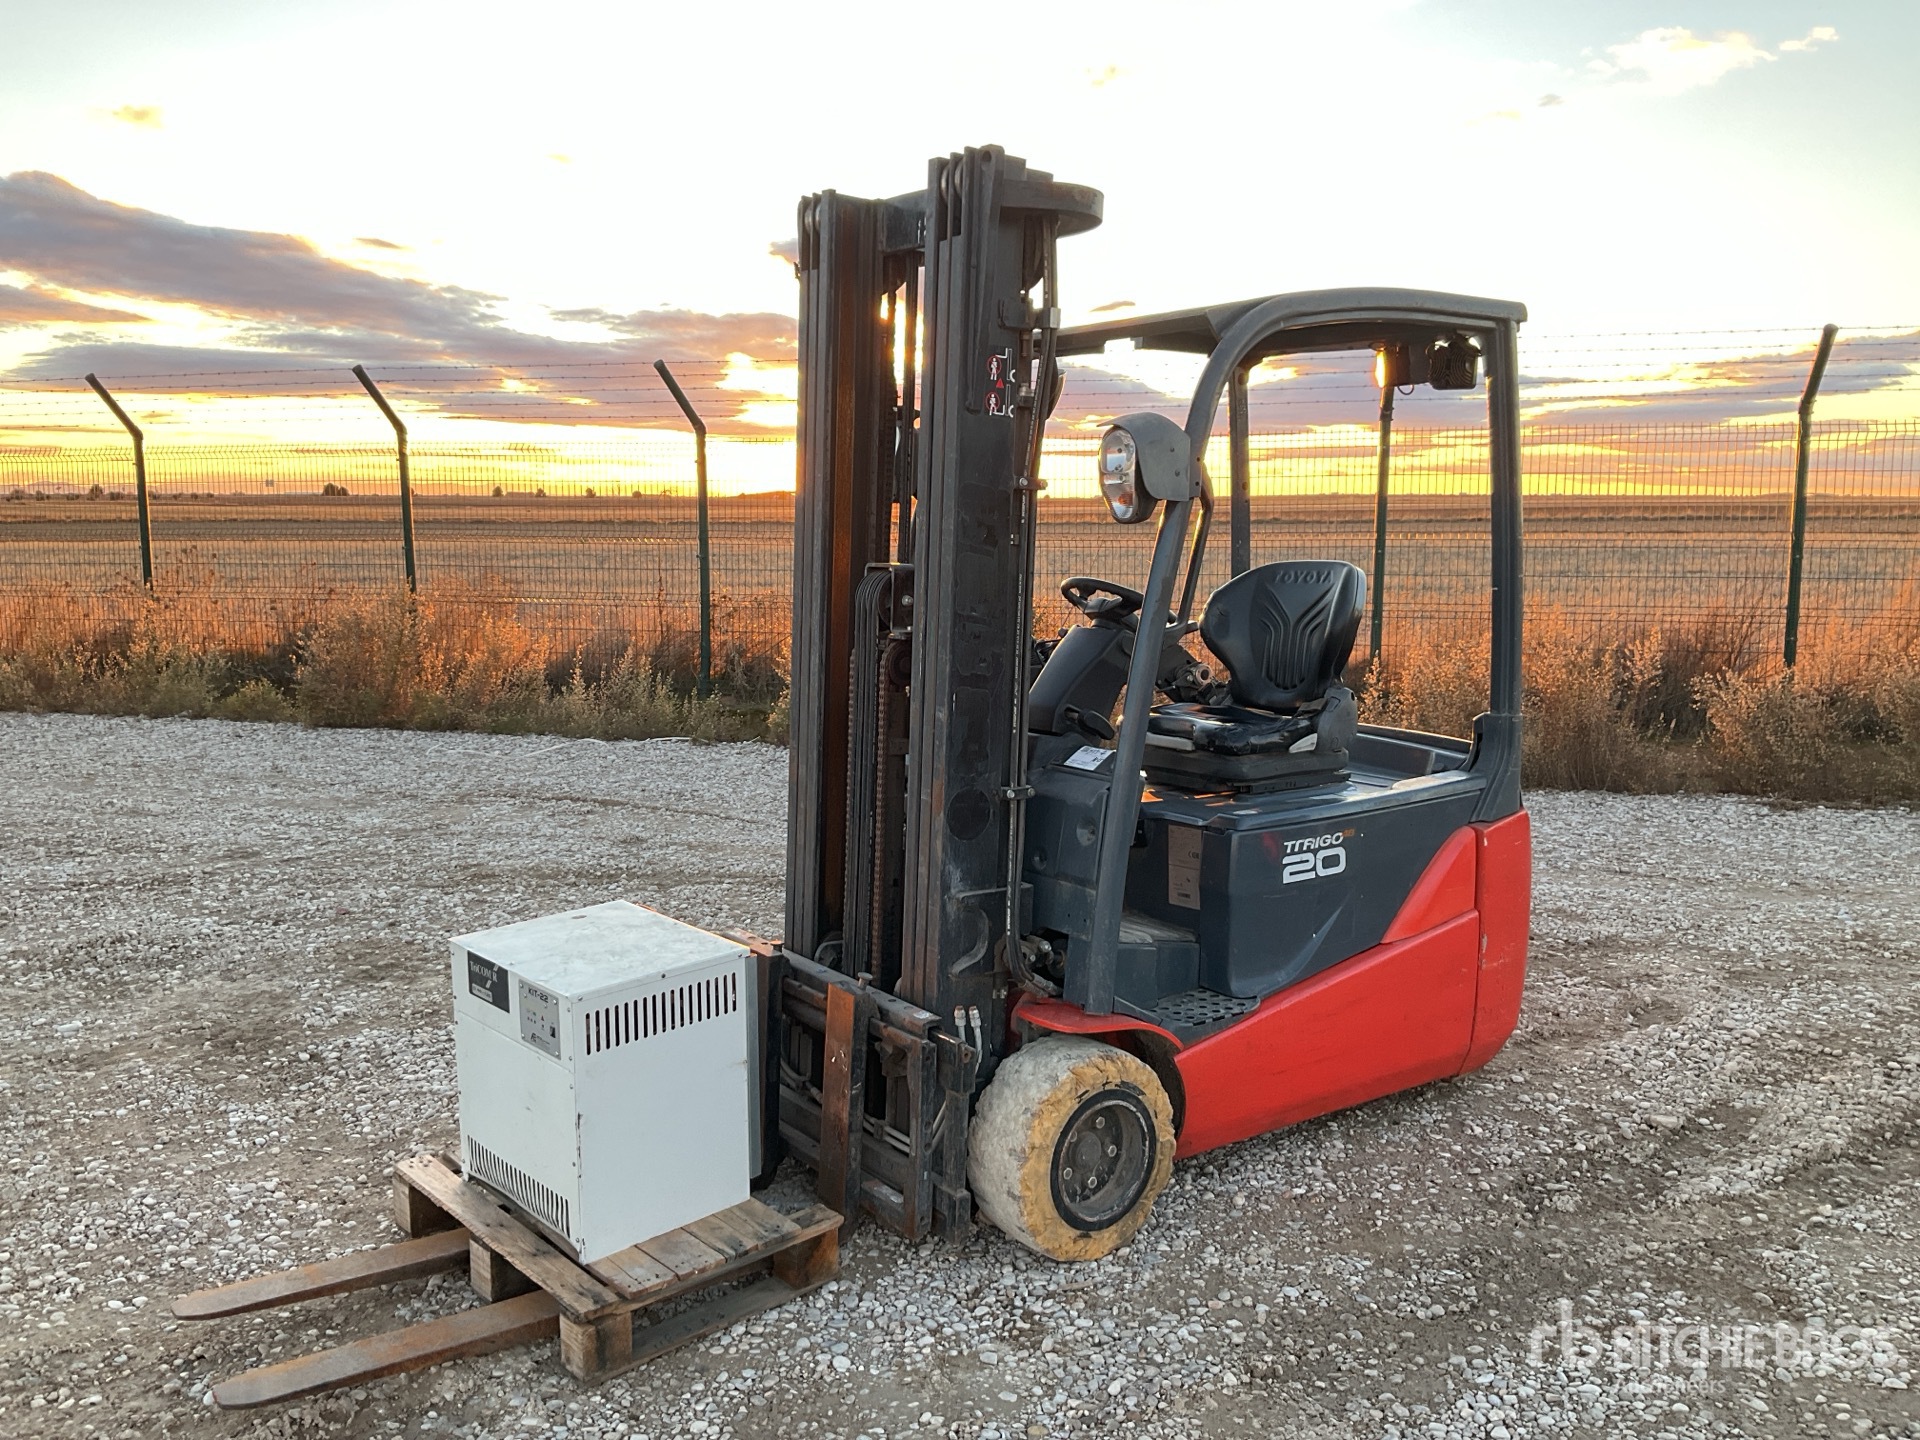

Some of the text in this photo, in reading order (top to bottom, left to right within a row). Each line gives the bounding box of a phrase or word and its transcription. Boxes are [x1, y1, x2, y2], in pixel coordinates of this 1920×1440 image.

[1275, 570, 1334, 584] TOYOTA
[1282, 846, 1346, 884] 20
[528, 987, 549, 1003] KIT-22
